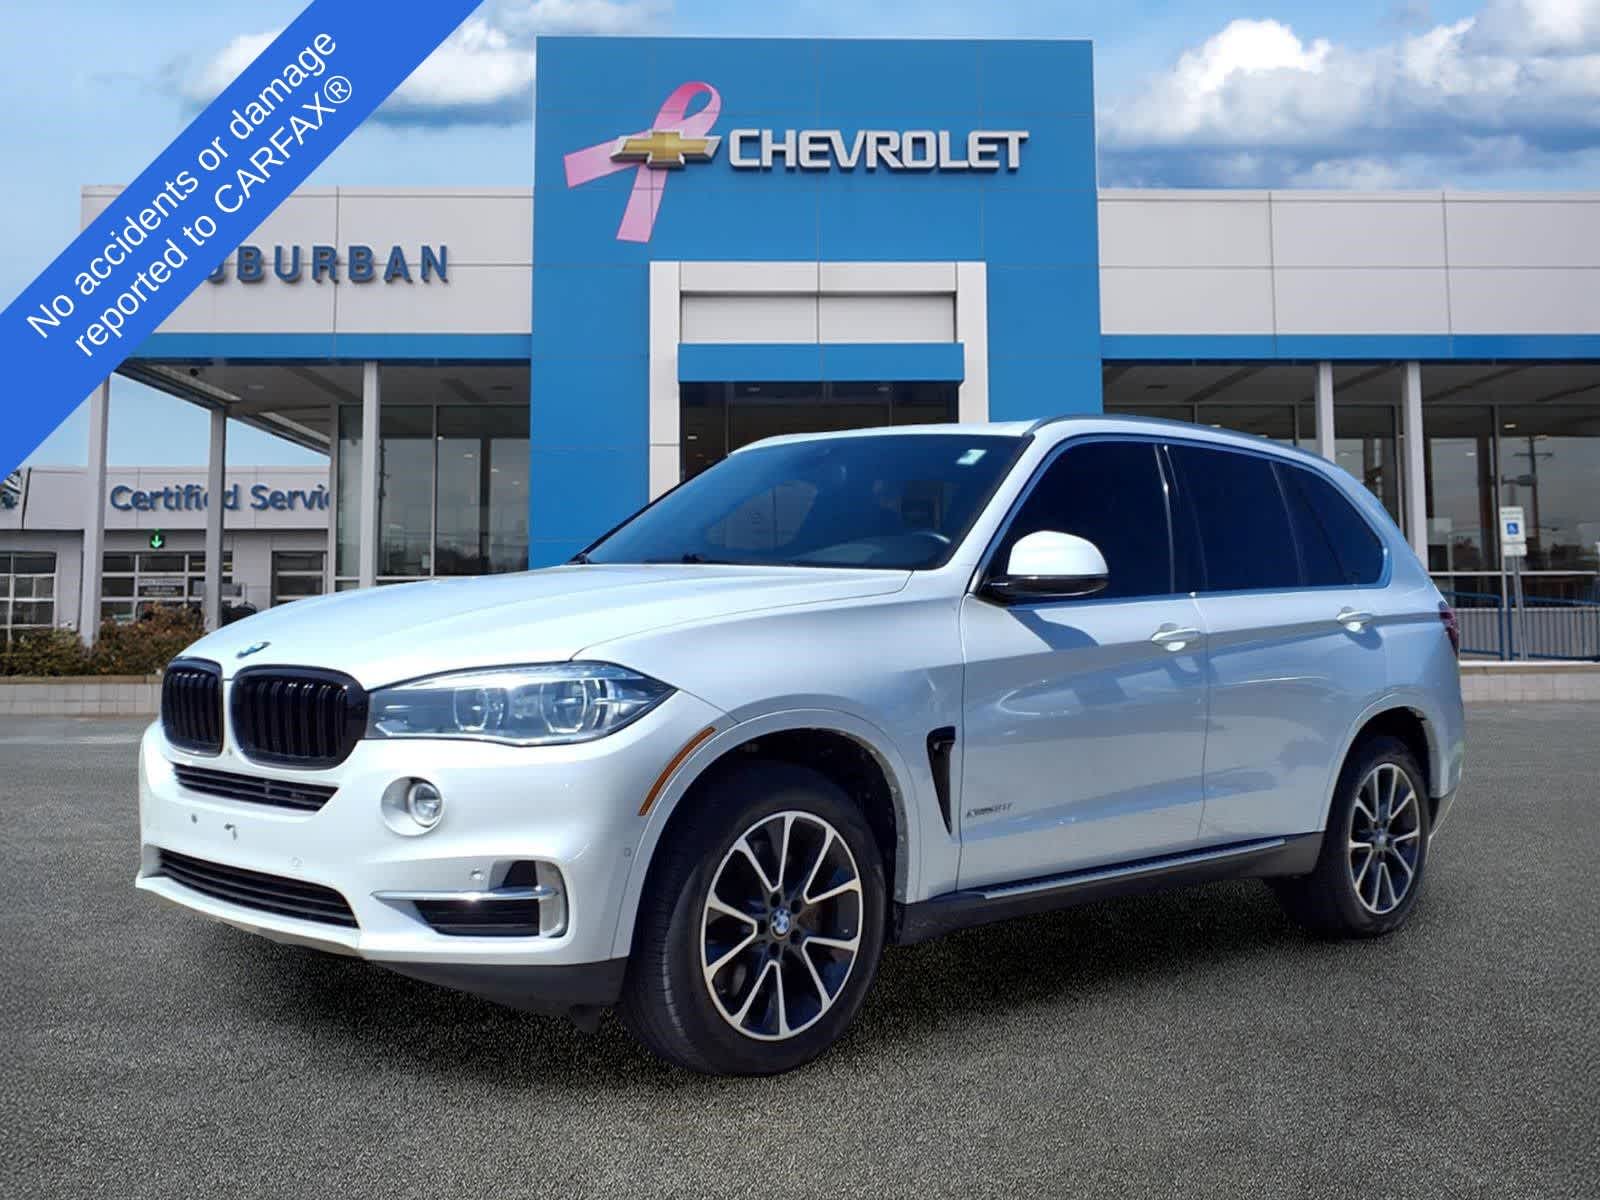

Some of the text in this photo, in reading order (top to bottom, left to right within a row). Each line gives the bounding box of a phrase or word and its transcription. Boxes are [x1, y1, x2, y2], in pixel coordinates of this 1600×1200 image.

[729, 129, 1029, 170] CHEVROLET
[110, 484, 330, 511] Certifid Servi
